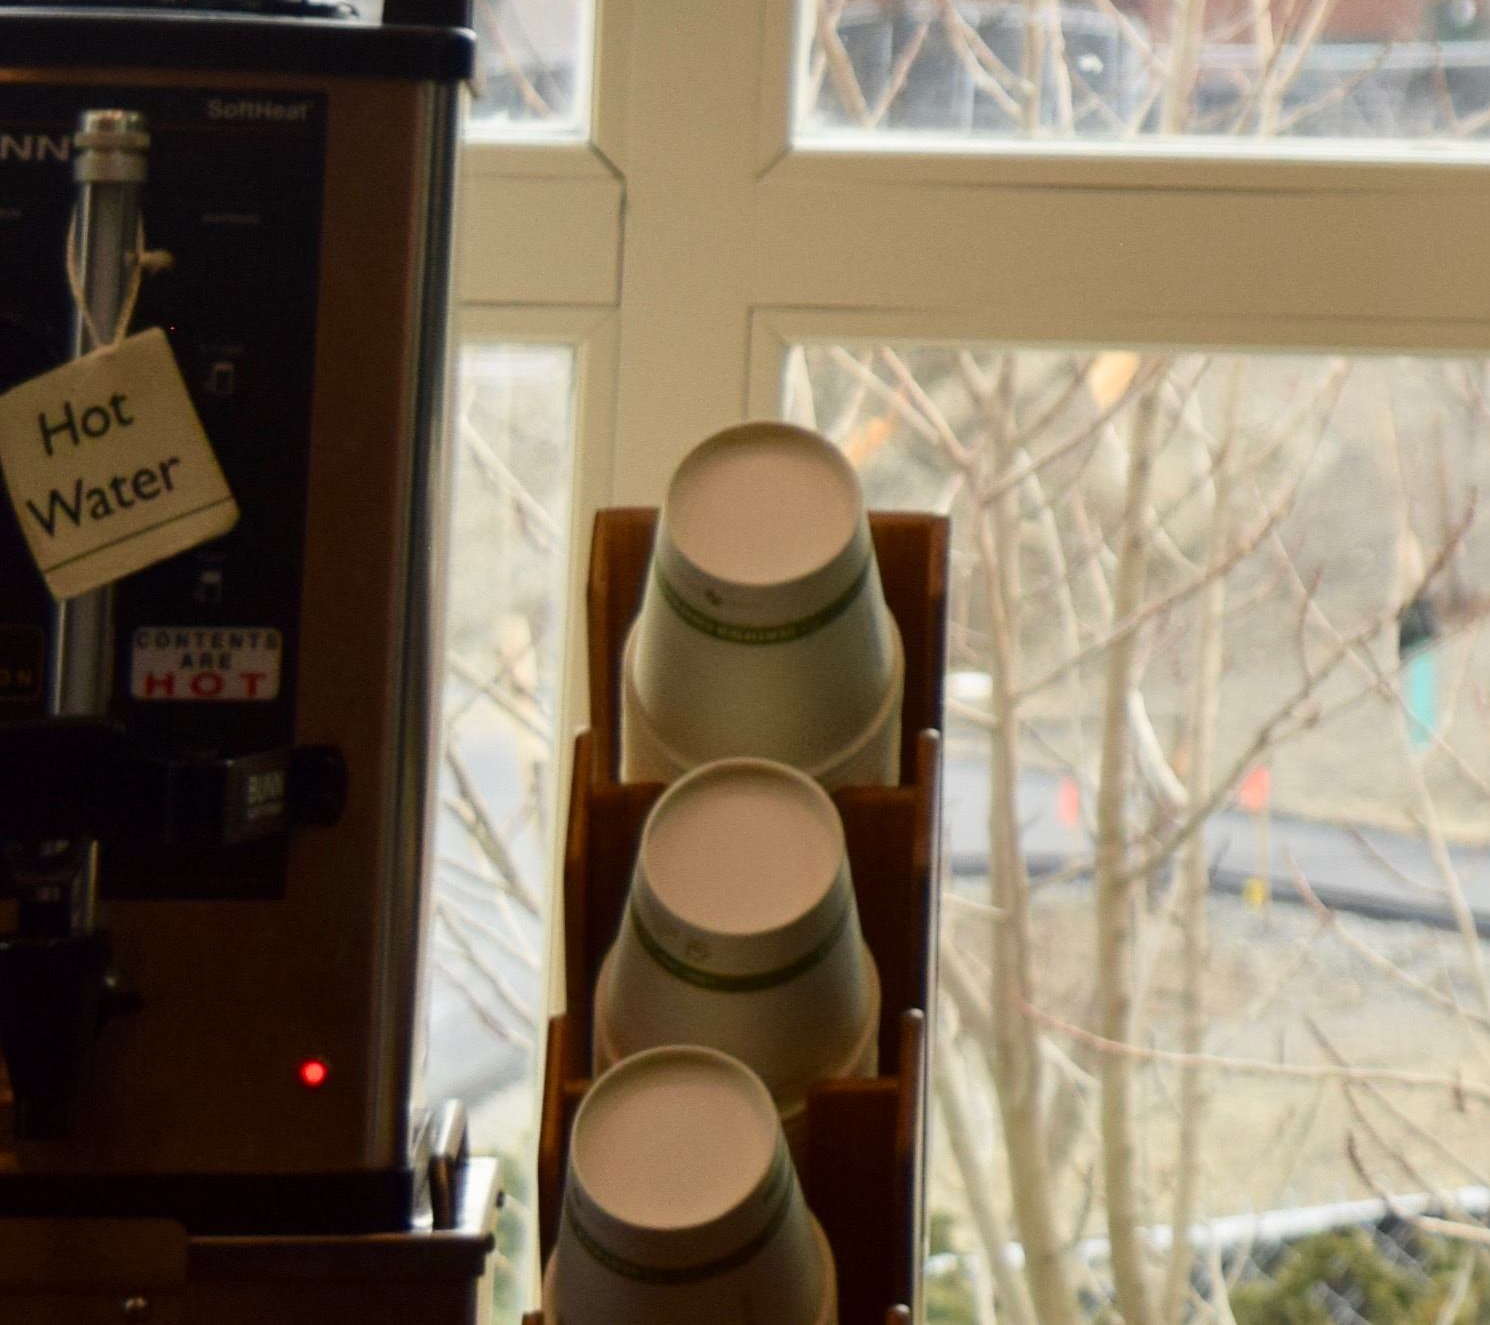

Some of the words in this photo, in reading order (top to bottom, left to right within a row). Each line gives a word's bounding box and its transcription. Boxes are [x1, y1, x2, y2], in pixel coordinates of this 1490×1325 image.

[37, 392, 135, 457] Hot
[25, 456, 181, 538] Water
[135, 630, 279, 650] CONTENTS
[179, 652, 233, 670] ARE
[145, 670, 267, 697] HOT
